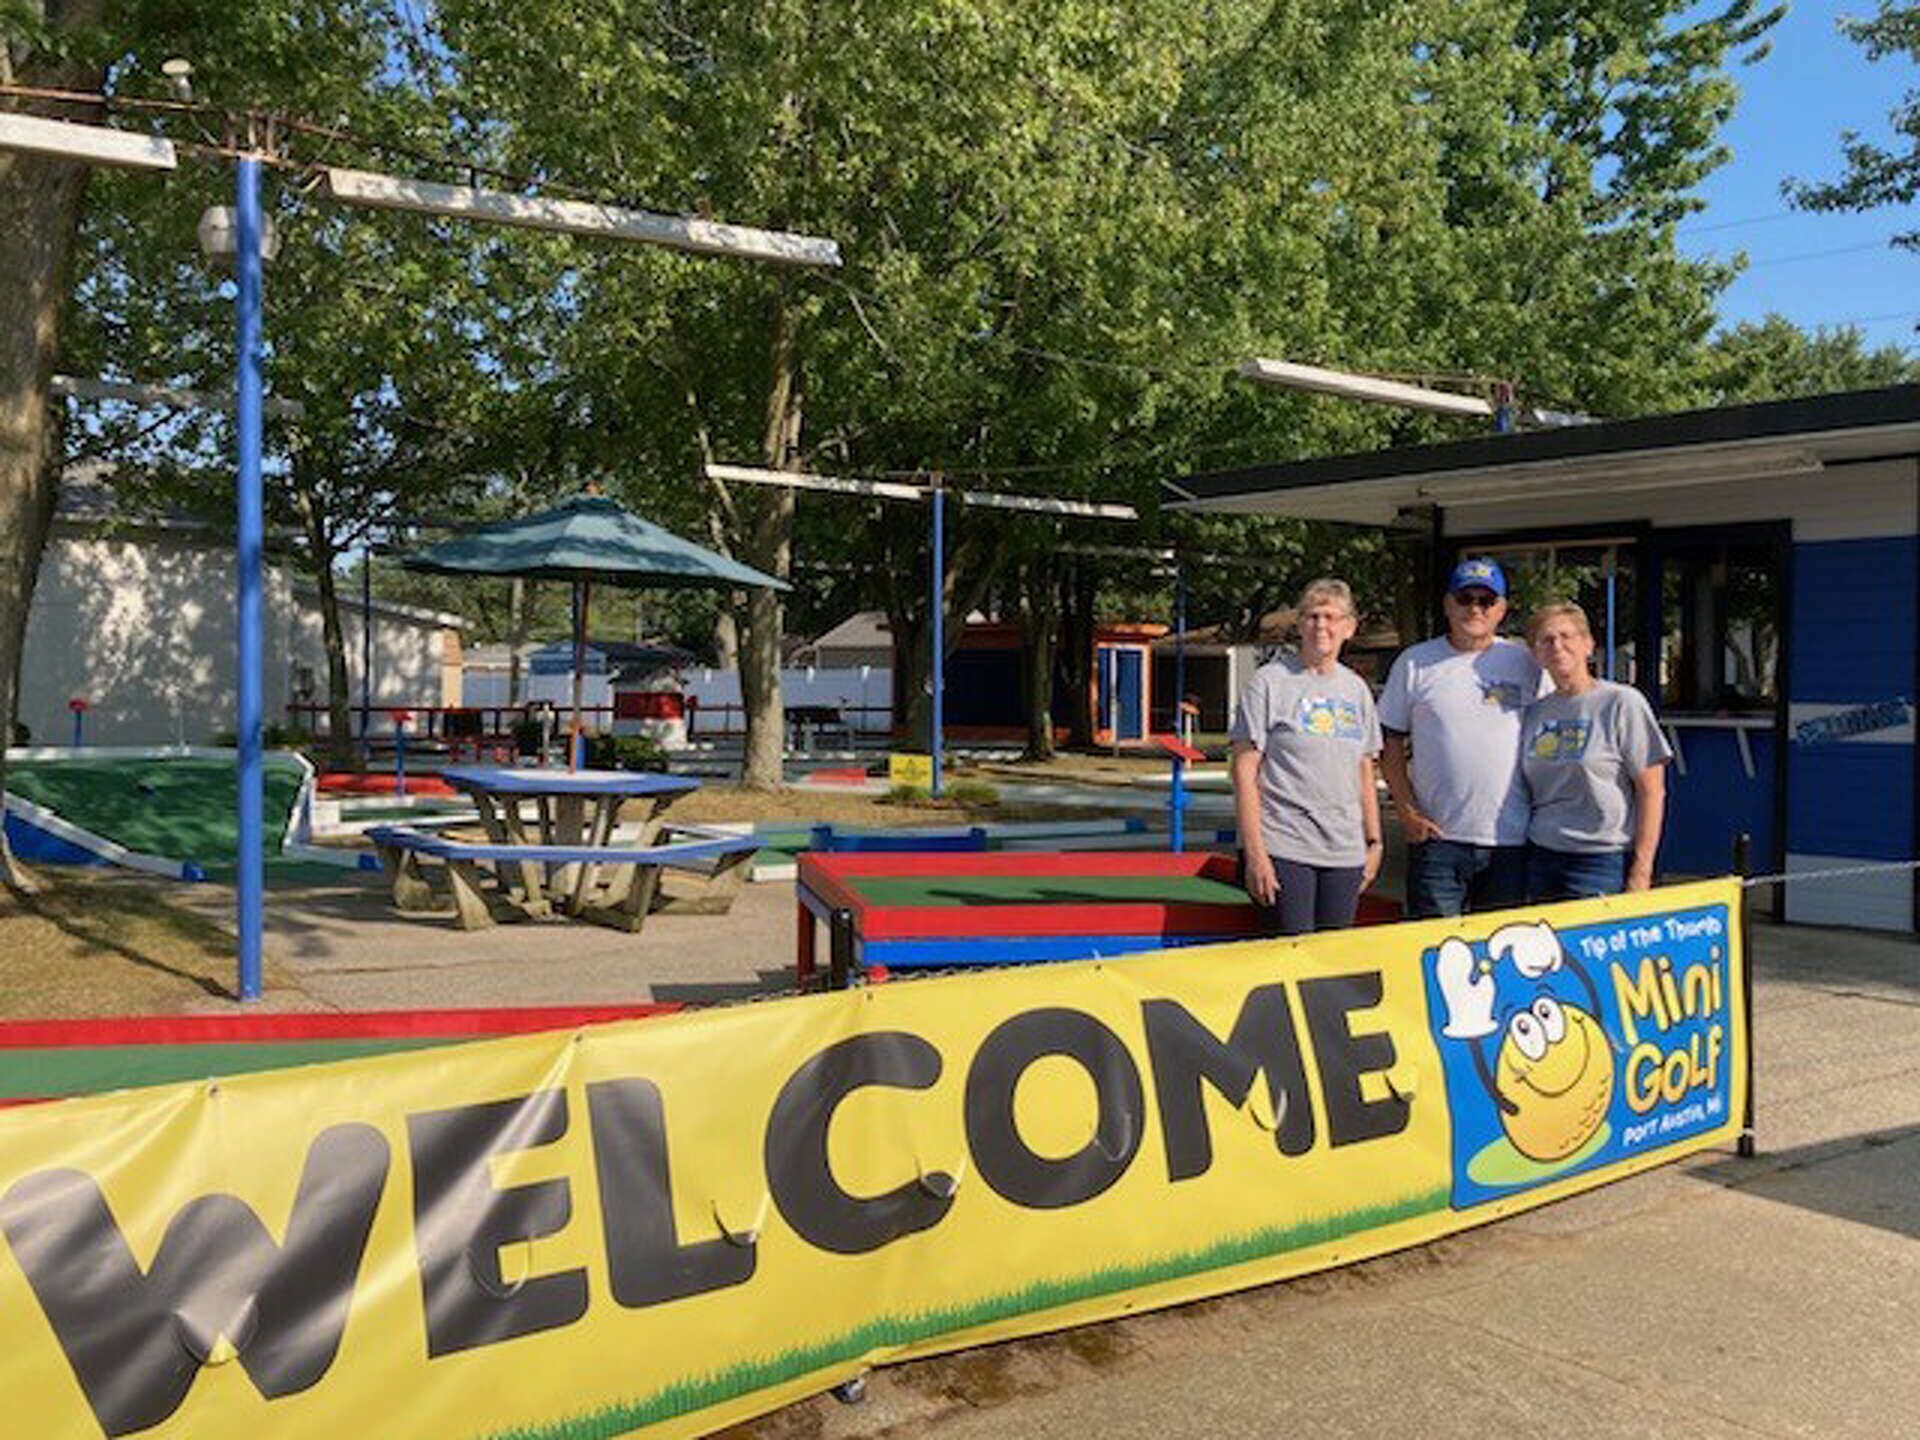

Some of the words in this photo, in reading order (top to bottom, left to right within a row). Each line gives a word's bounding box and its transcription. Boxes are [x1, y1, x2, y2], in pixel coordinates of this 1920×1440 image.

[1580, 935, 1607, 960] Tip
[1611, 945, 1722, 1046] Mini
[2, 970, 1414, 1438] WELCOME
